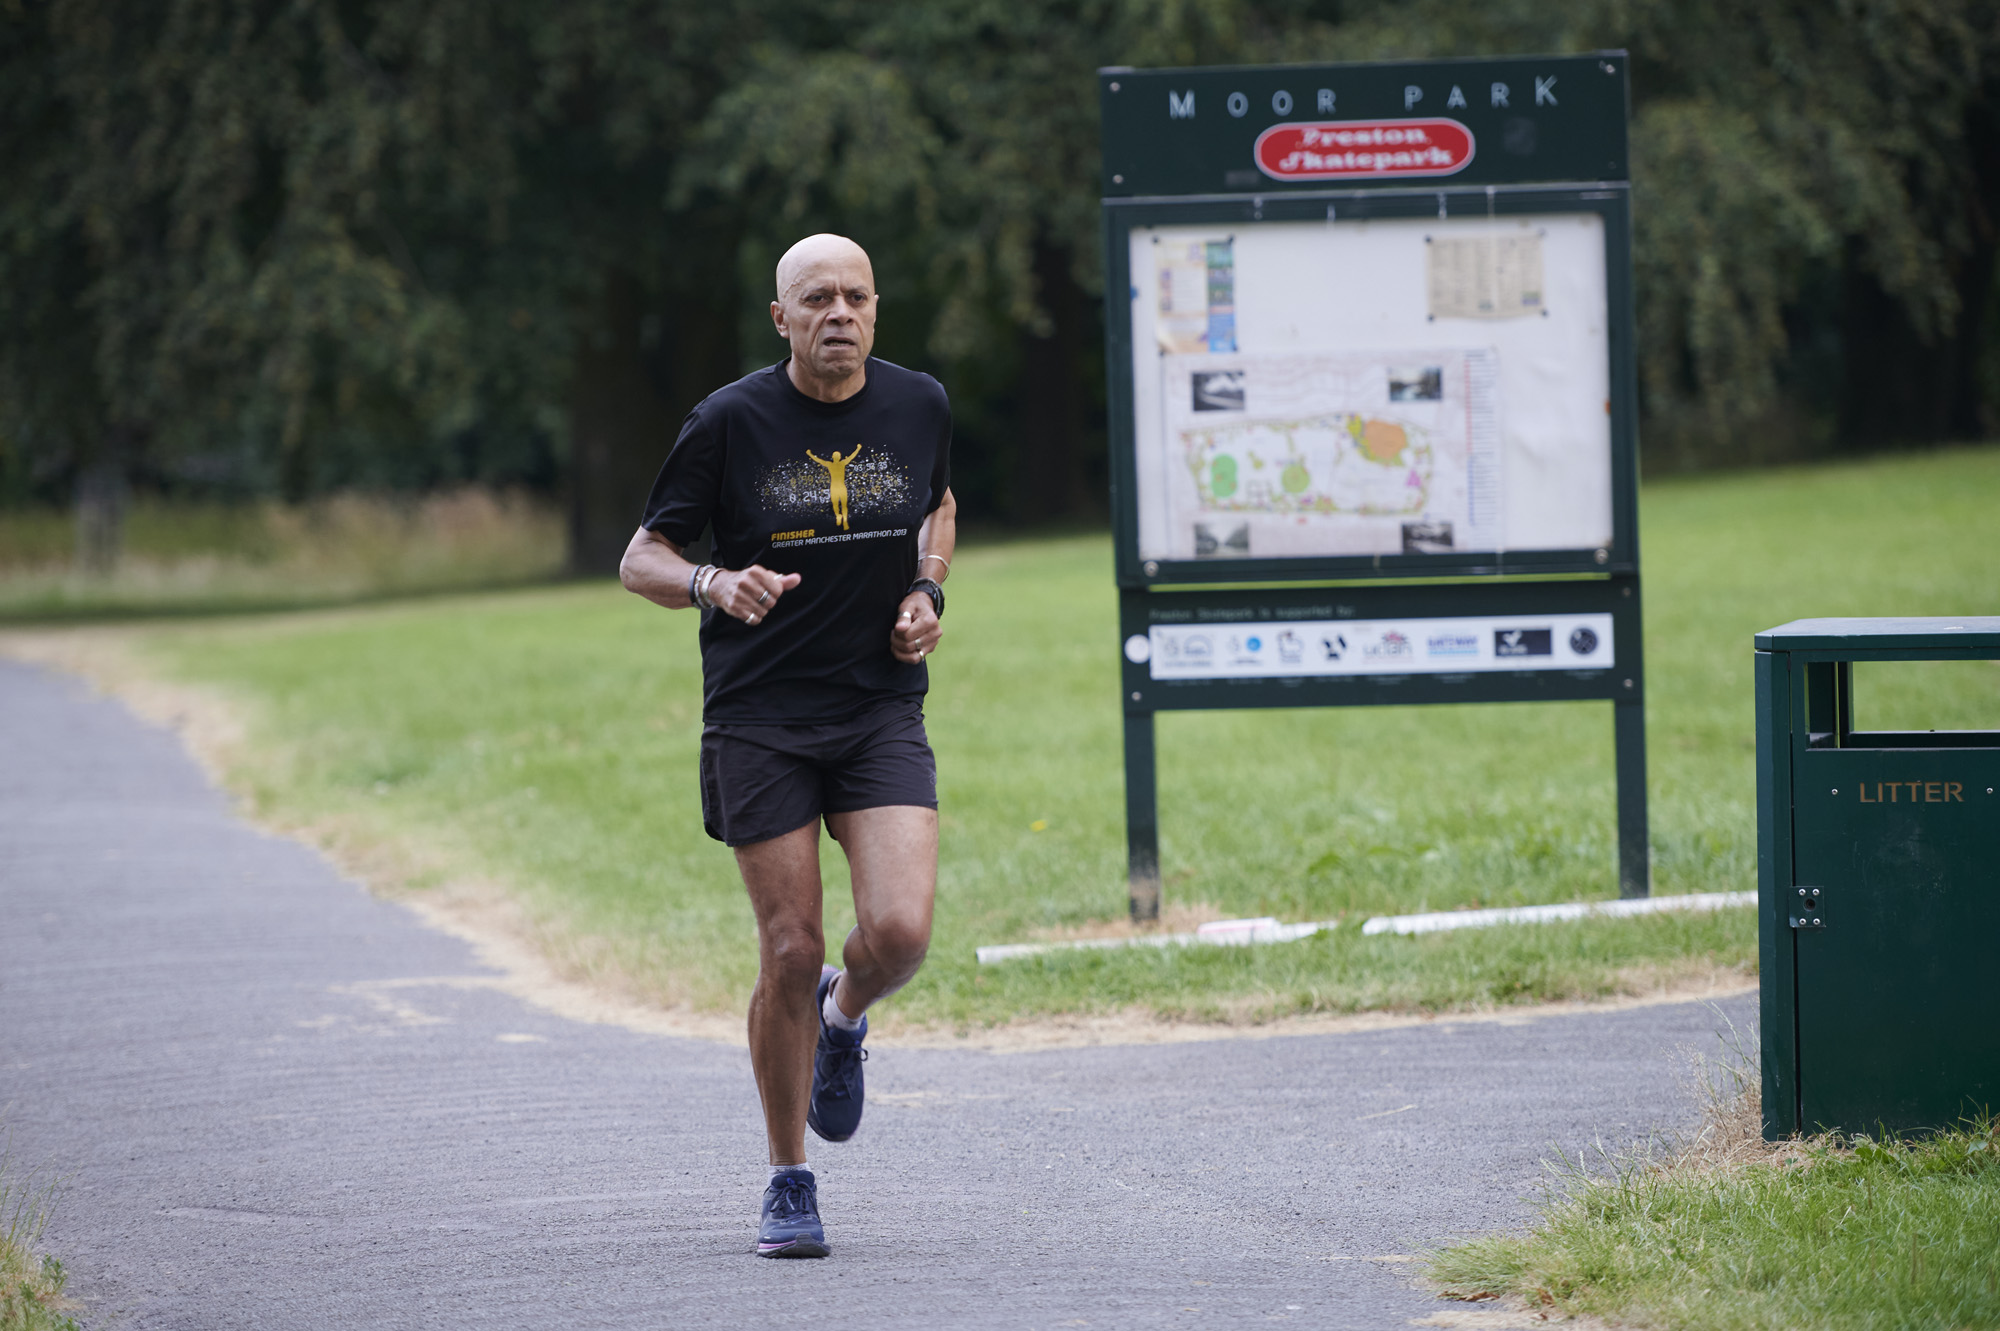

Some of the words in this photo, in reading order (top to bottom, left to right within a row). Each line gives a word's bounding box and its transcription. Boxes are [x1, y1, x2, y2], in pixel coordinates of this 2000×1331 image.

[1169, 88, 1337, 120] MOOR
[1404, 76, 1559, 111] PARK
[1299, 127, 1428, 148] Preston
[1278, 147, 1453, 171] Skatepark
[771, 528, 816, 541] FINISHER
[771, 539, 804, 549] GREATER
[804, 534, 852, 546] MANCHESTER
[852, 529, 892, 541] MARATHON
[892, 528, 908, 537] 2013
[1859, 781, 1965, 803] LITTER
